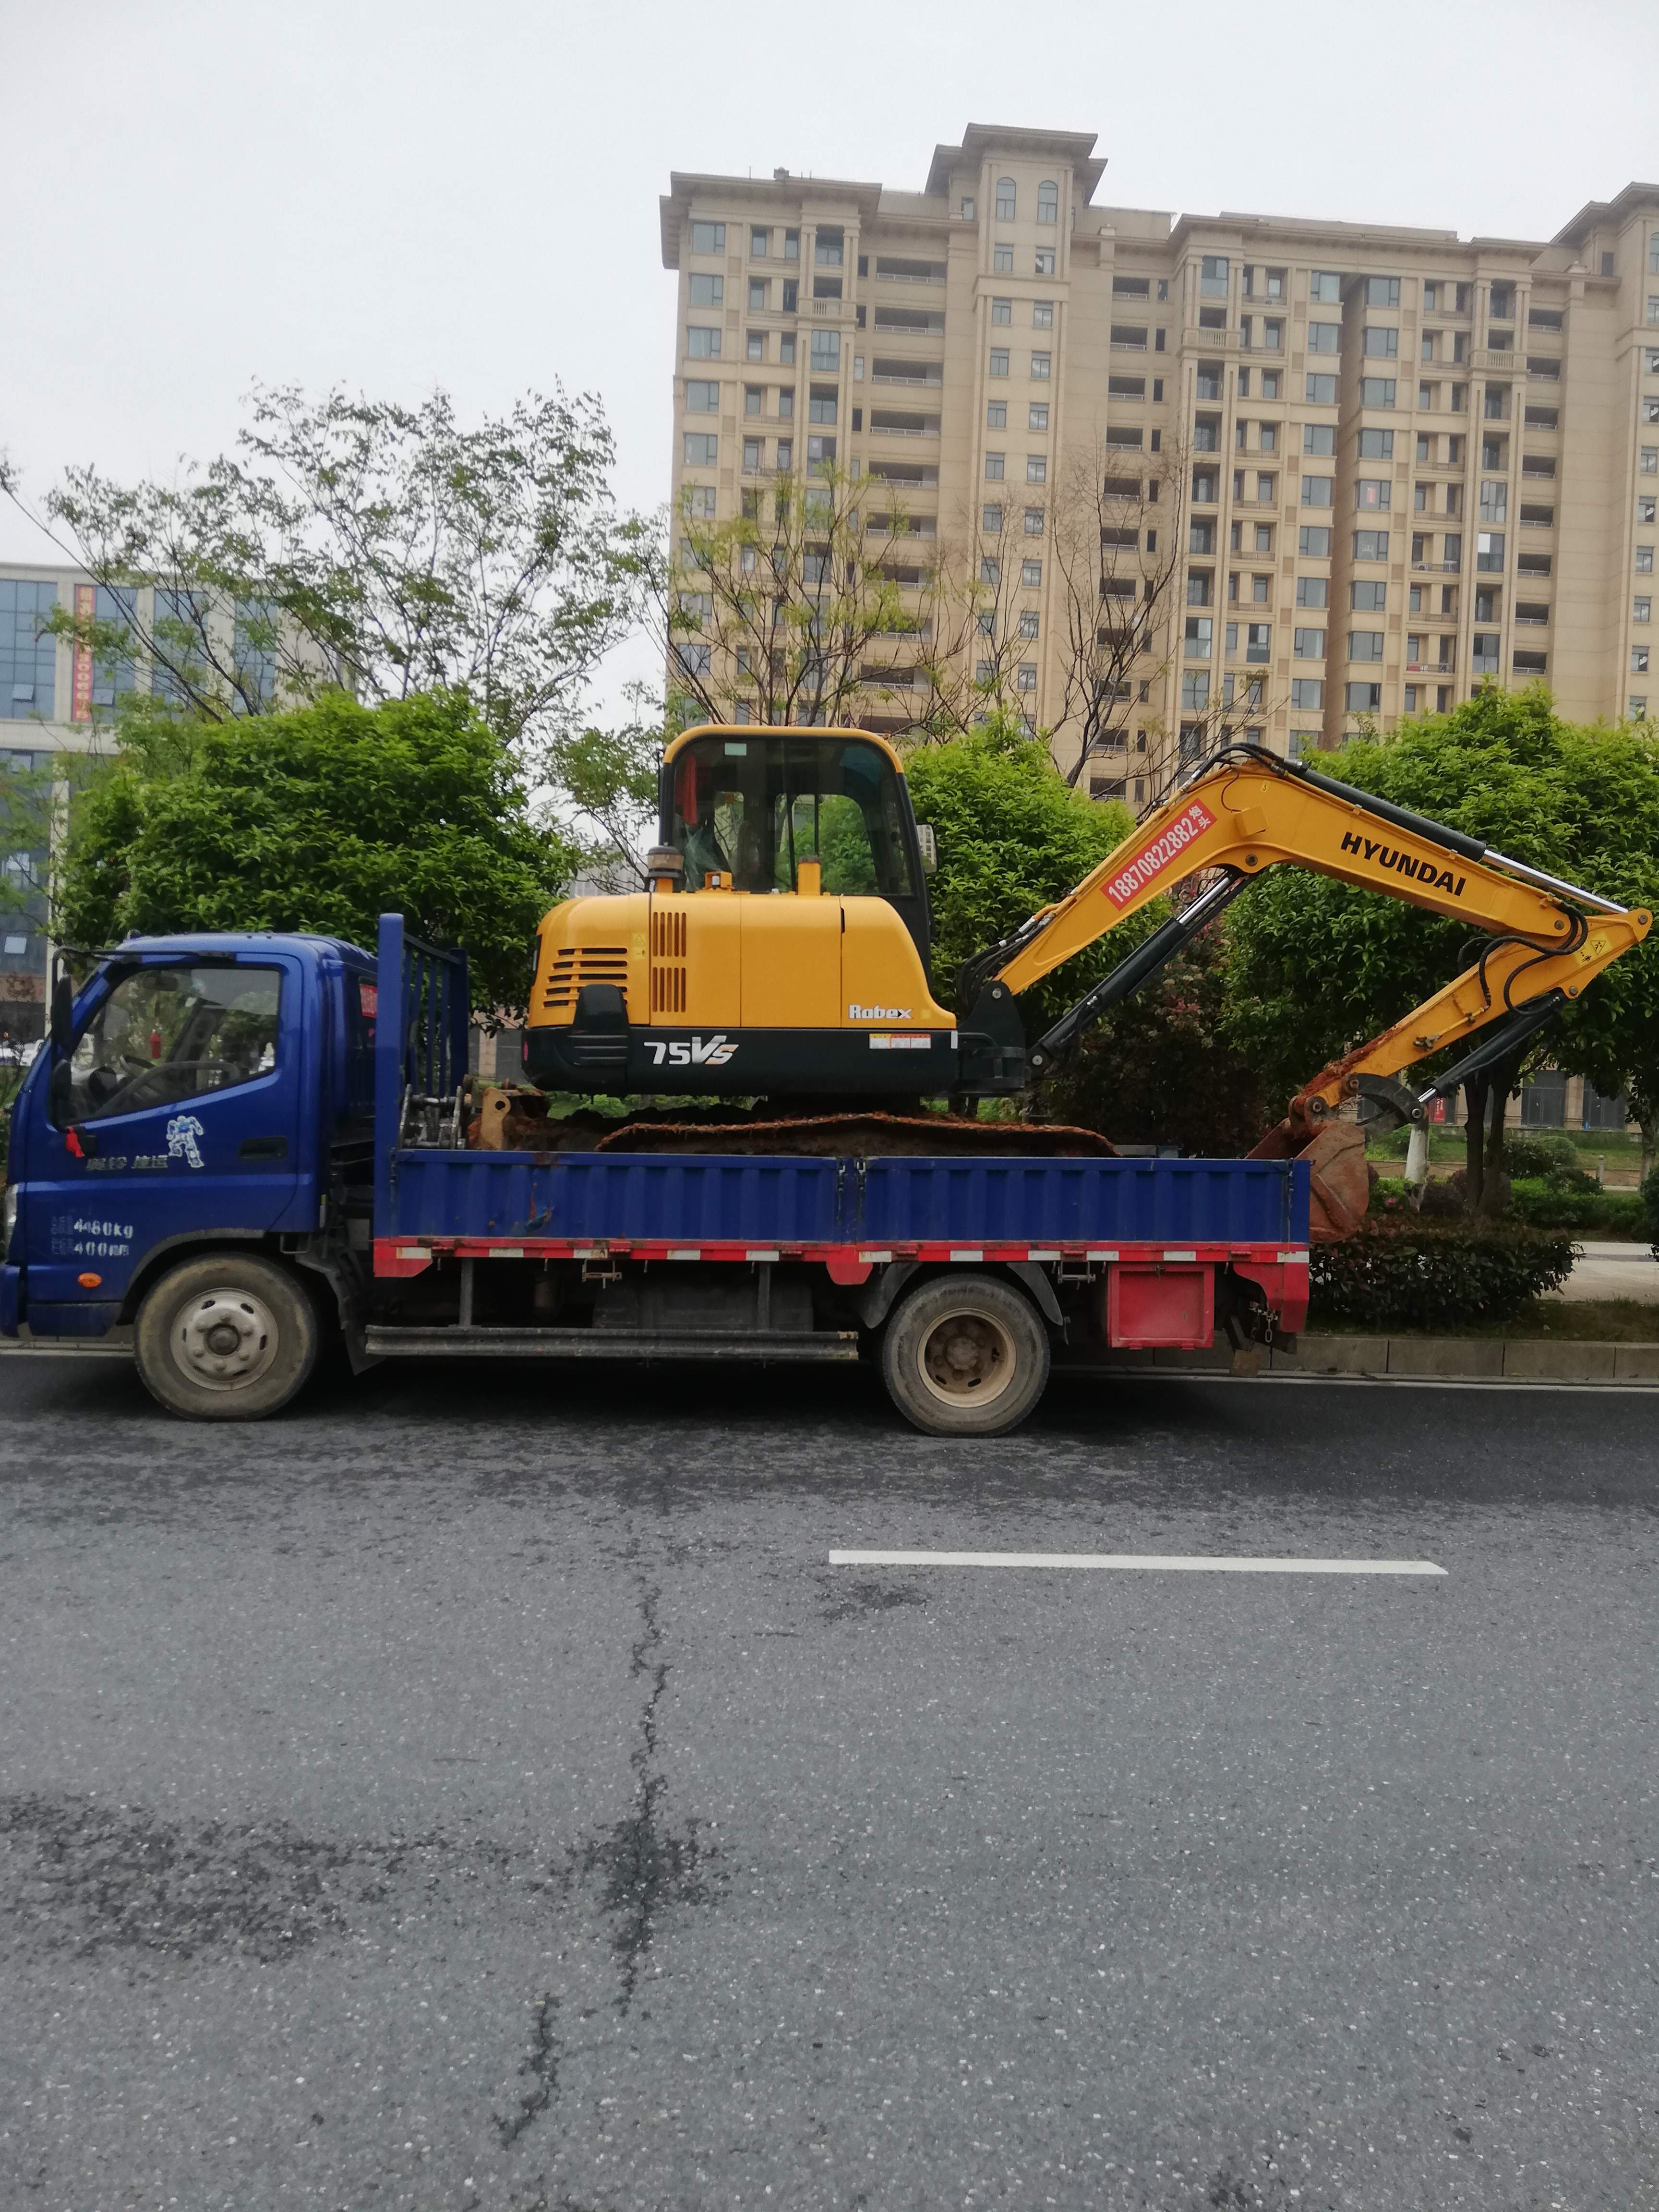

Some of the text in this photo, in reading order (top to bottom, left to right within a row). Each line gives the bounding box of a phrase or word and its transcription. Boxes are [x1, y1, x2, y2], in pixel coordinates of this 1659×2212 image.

[1189, 805, 1211, 830] 炮头
[1108, 817, 1199, 902] 18870822882
[1341, 831, 1466, 897] HYUNDAI
